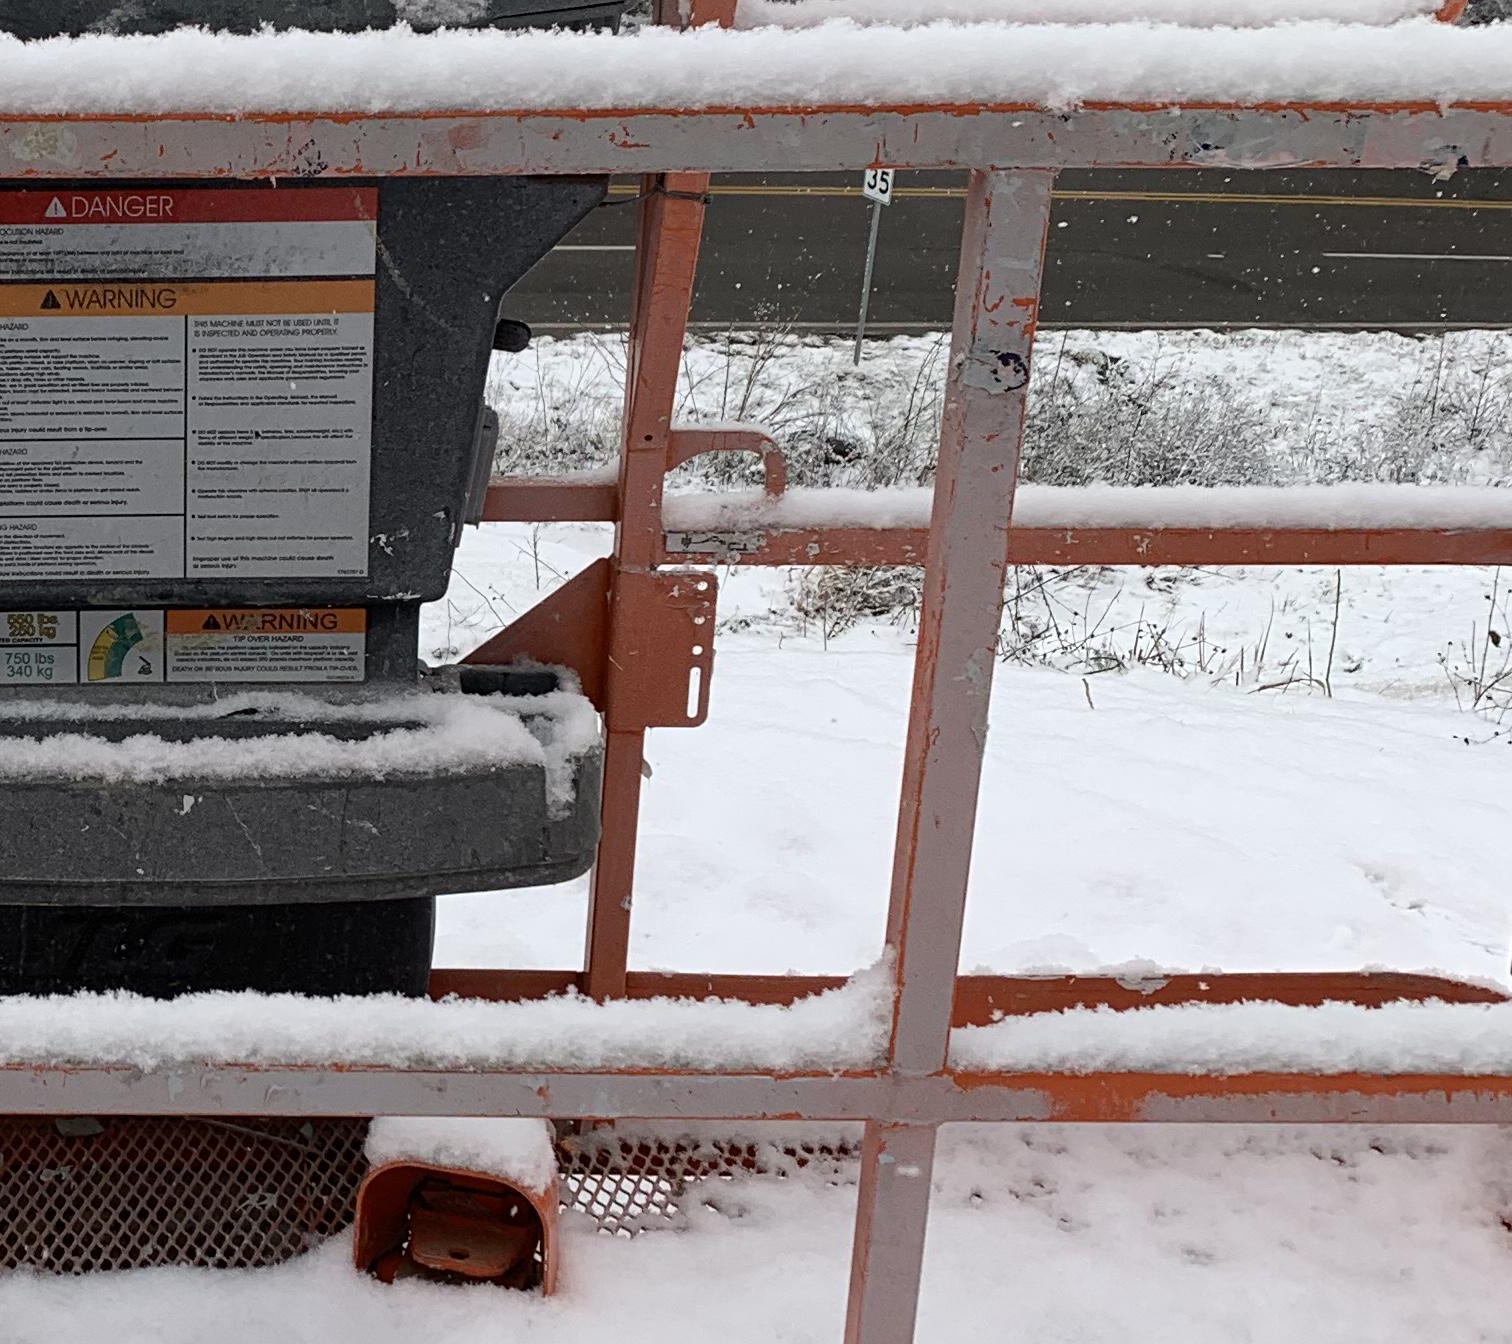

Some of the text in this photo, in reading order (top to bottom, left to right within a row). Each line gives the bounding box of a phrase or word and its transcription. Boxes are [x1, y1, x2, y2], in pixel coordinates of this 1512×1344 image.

[867, 169, 890, 194] 35
[71, 195, 174, 217] DANGER
[35, 227, 64, 236] HAZARD
[65, 288, 177, 309] WARNING
[0, 322, 29, 331] HAZARD
[246, 319, 264, 327] MUST
[266, 319, 282, 327] NOT
[282, 319, 291, 327] BE
[313, 318, 332, 326] UNTIL
[202, 329, 240, 337] INSPECTED
[242, 329, 258, 337] AND
[0, 448, 28, 456] HAZARD
[9, 523, 38, 531] HAZARD
[8, 624, 56, 639] 250 kg
[5, 652, 55, 664] 750 lbs
[6, 665, 53, 680] 340 kg
